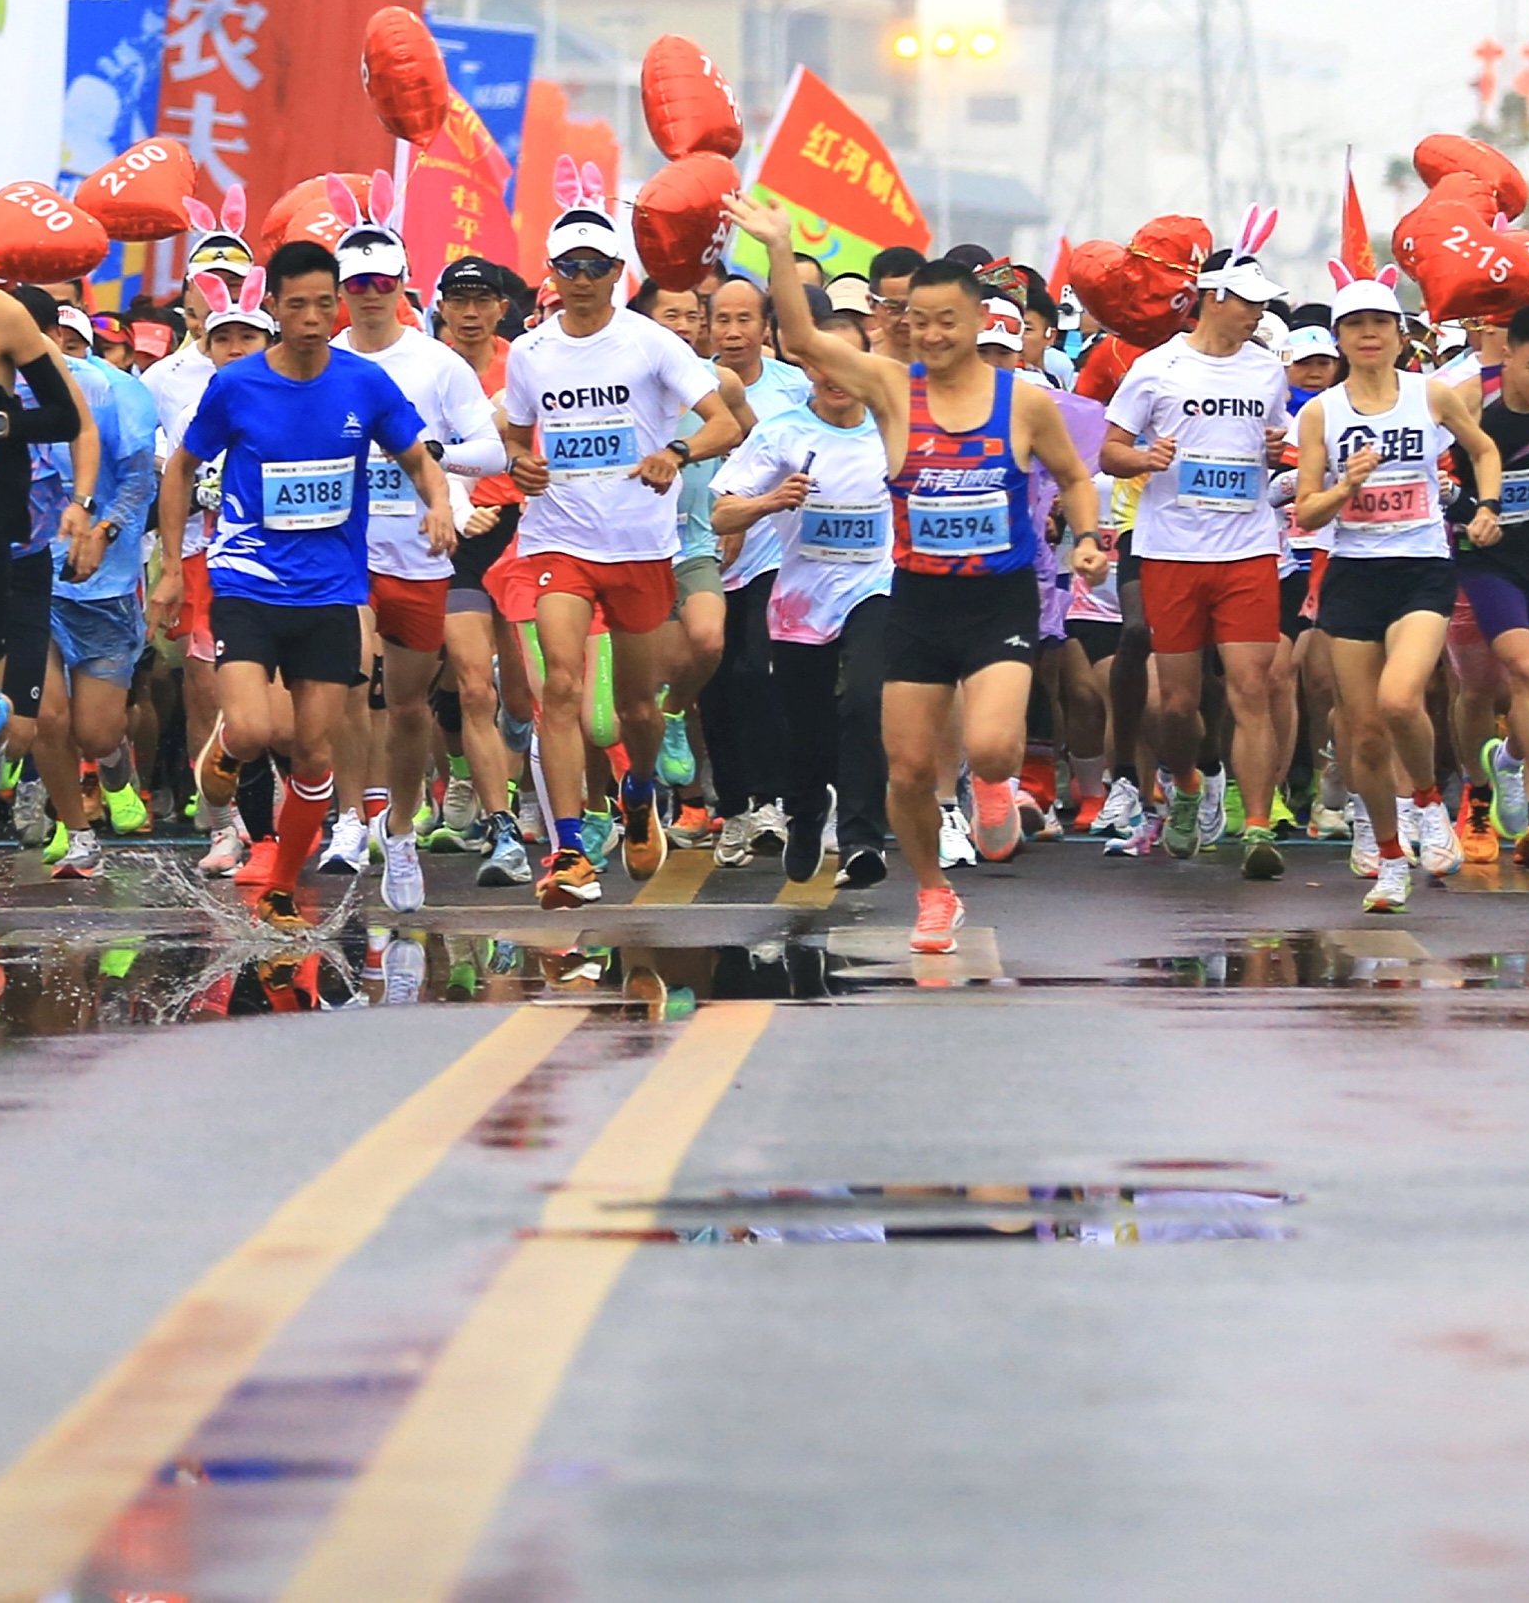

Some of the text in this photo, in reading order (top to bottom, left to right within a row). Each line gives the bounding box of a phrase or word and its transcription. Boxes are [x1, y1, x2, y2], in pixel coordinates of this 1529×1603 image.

[100, 144, 169, 196] 2:00
[4, 185, 74, 232] 2:00
[1442, 225, 1515, 284] 2:15
[553, 435, 620, 460] A2209
[1191, 468, 1247, 491] A1091
[275, 479, 344, 508] A3188
[1349, 489, 1415, 514] A0637
[815, 518, 875, 539] A1731
[918, 514, 995, 540] A2594
